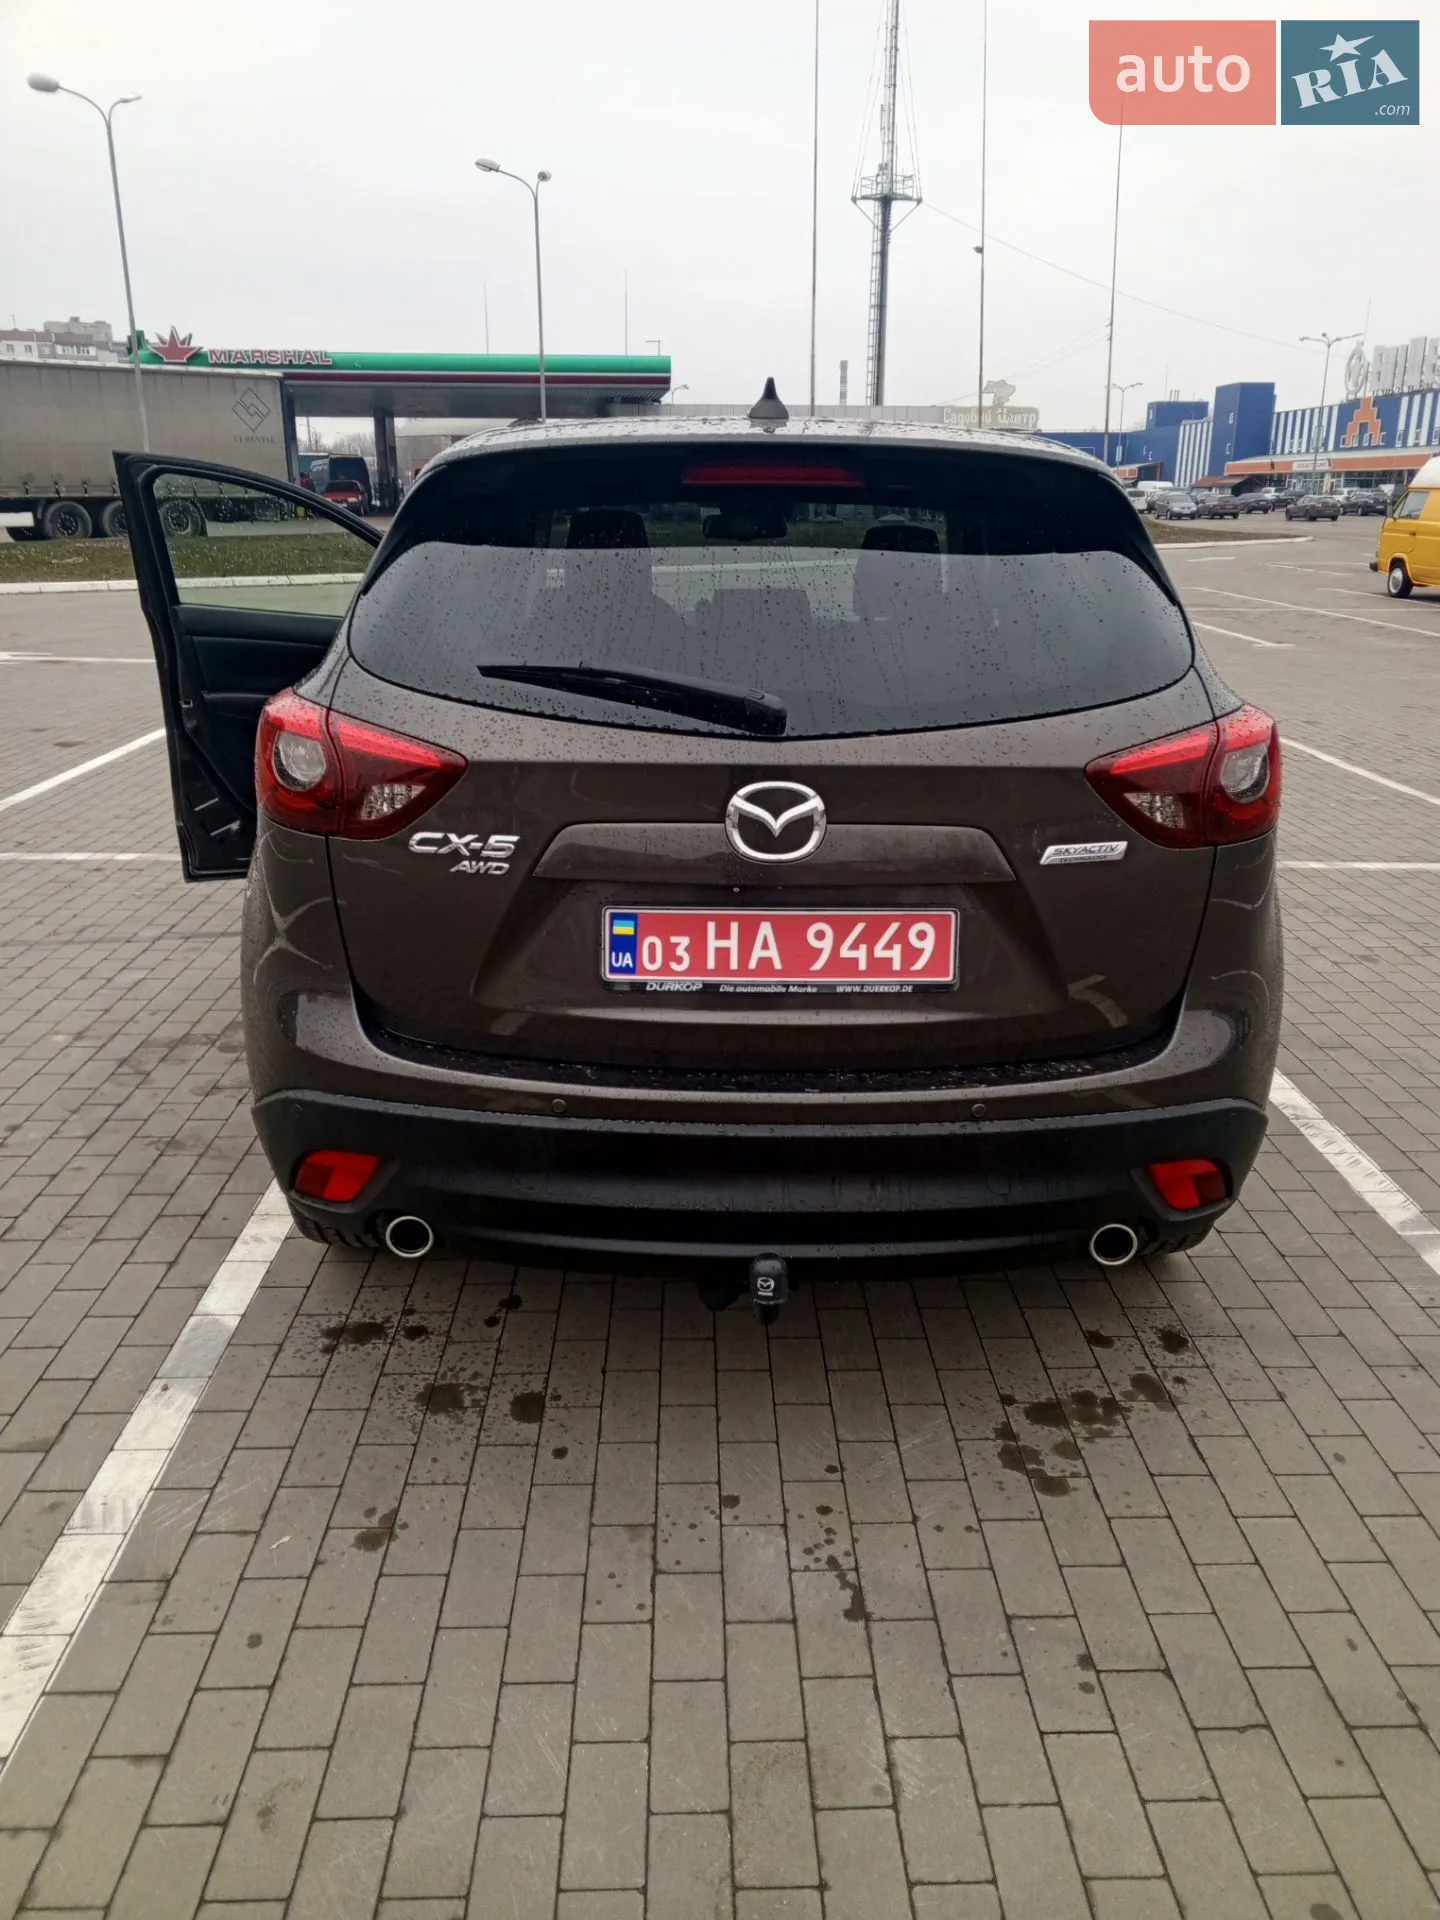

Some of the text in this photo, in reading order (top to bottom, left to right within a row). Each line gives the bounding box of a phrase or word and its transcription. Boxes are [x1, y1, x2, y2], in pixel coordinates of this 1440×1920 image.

[208, 349, 333, 365] MARSHAL
[408, 831, 520, 858] CX-5
[1053, 844, 1118, 855] SKYACTIV
[449, 860, 510, 875] AWD
[641, 921, 936, 972] 03 HA 9449
[611, 951, 633, 968] UA
[719, 984, 818, 993] Die automobile Marke
[836, 985, 913, 993] WWW.DUERKOP.DE
